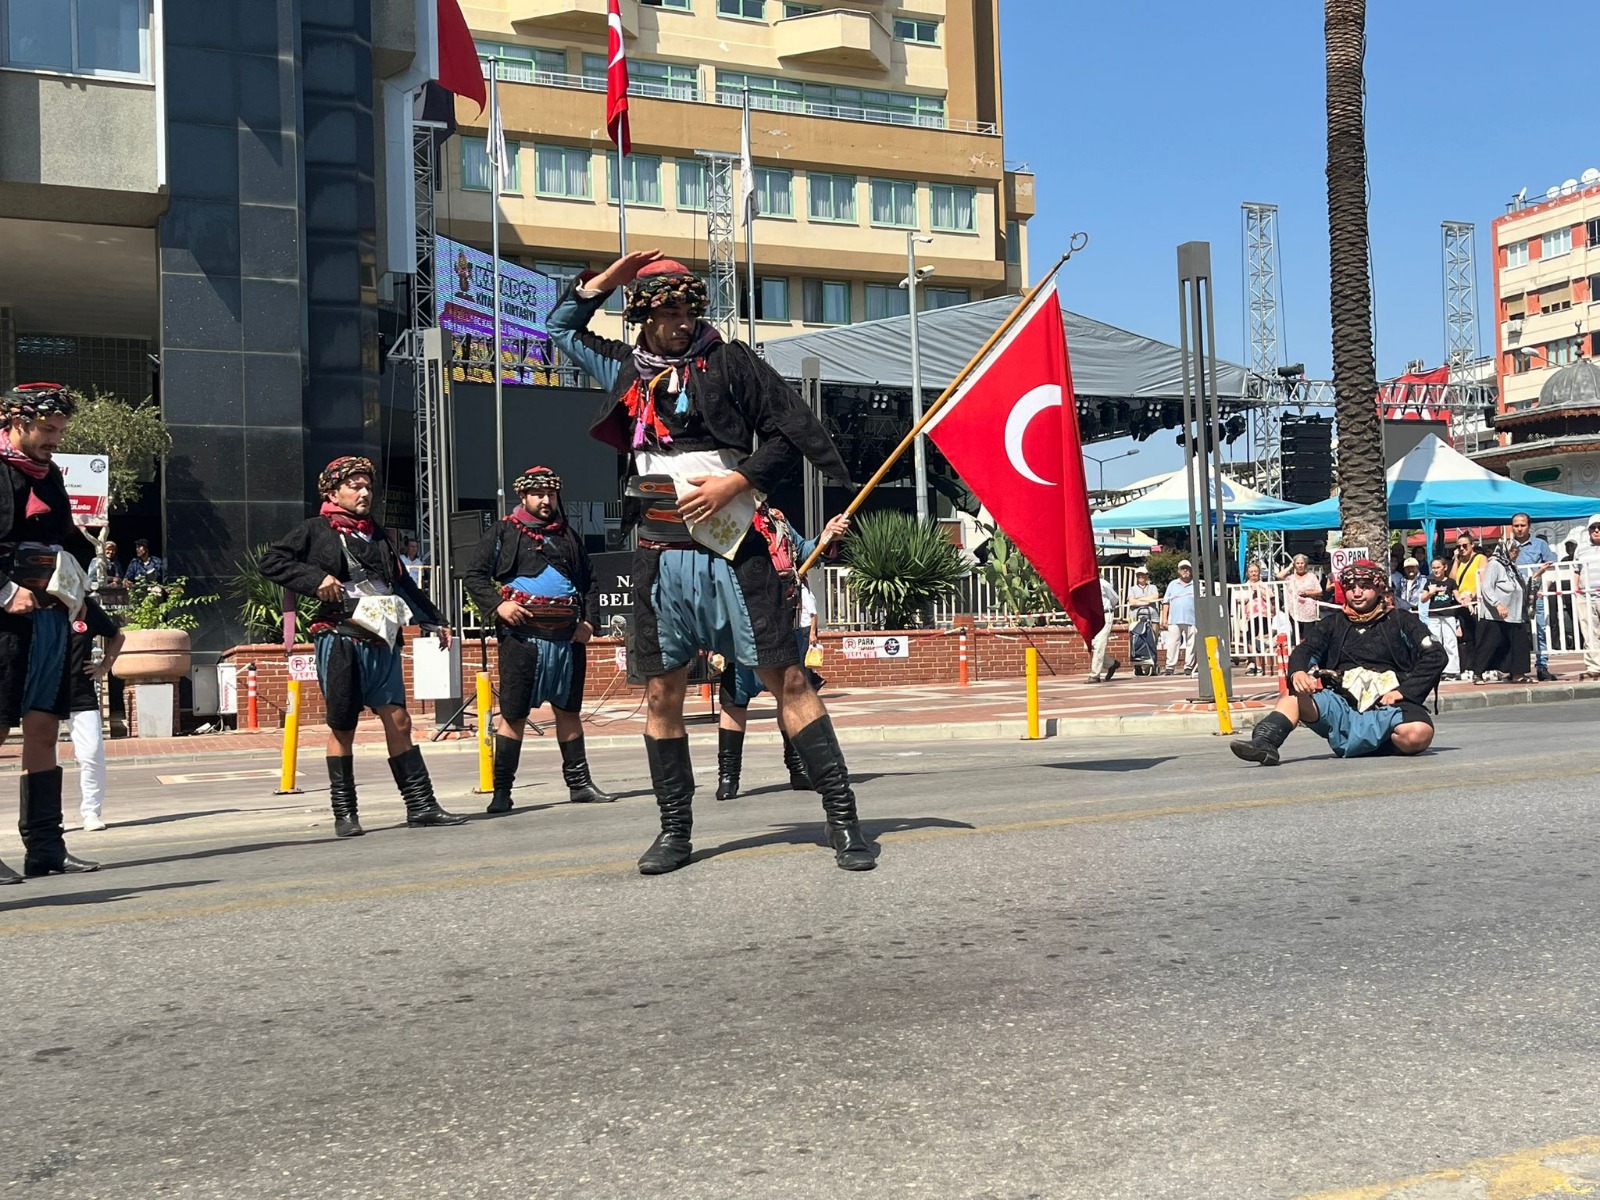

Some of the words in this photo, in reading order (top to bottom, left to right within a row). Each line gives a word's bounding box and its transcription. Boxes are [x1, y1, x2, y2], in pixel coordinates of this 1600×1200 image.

[476, 291, 497, 309] KİTA
[1348, 550, 1367, 562] PARK
[599, 592, 634, 607] BEL
[857, 638, 875, 646] PARK
